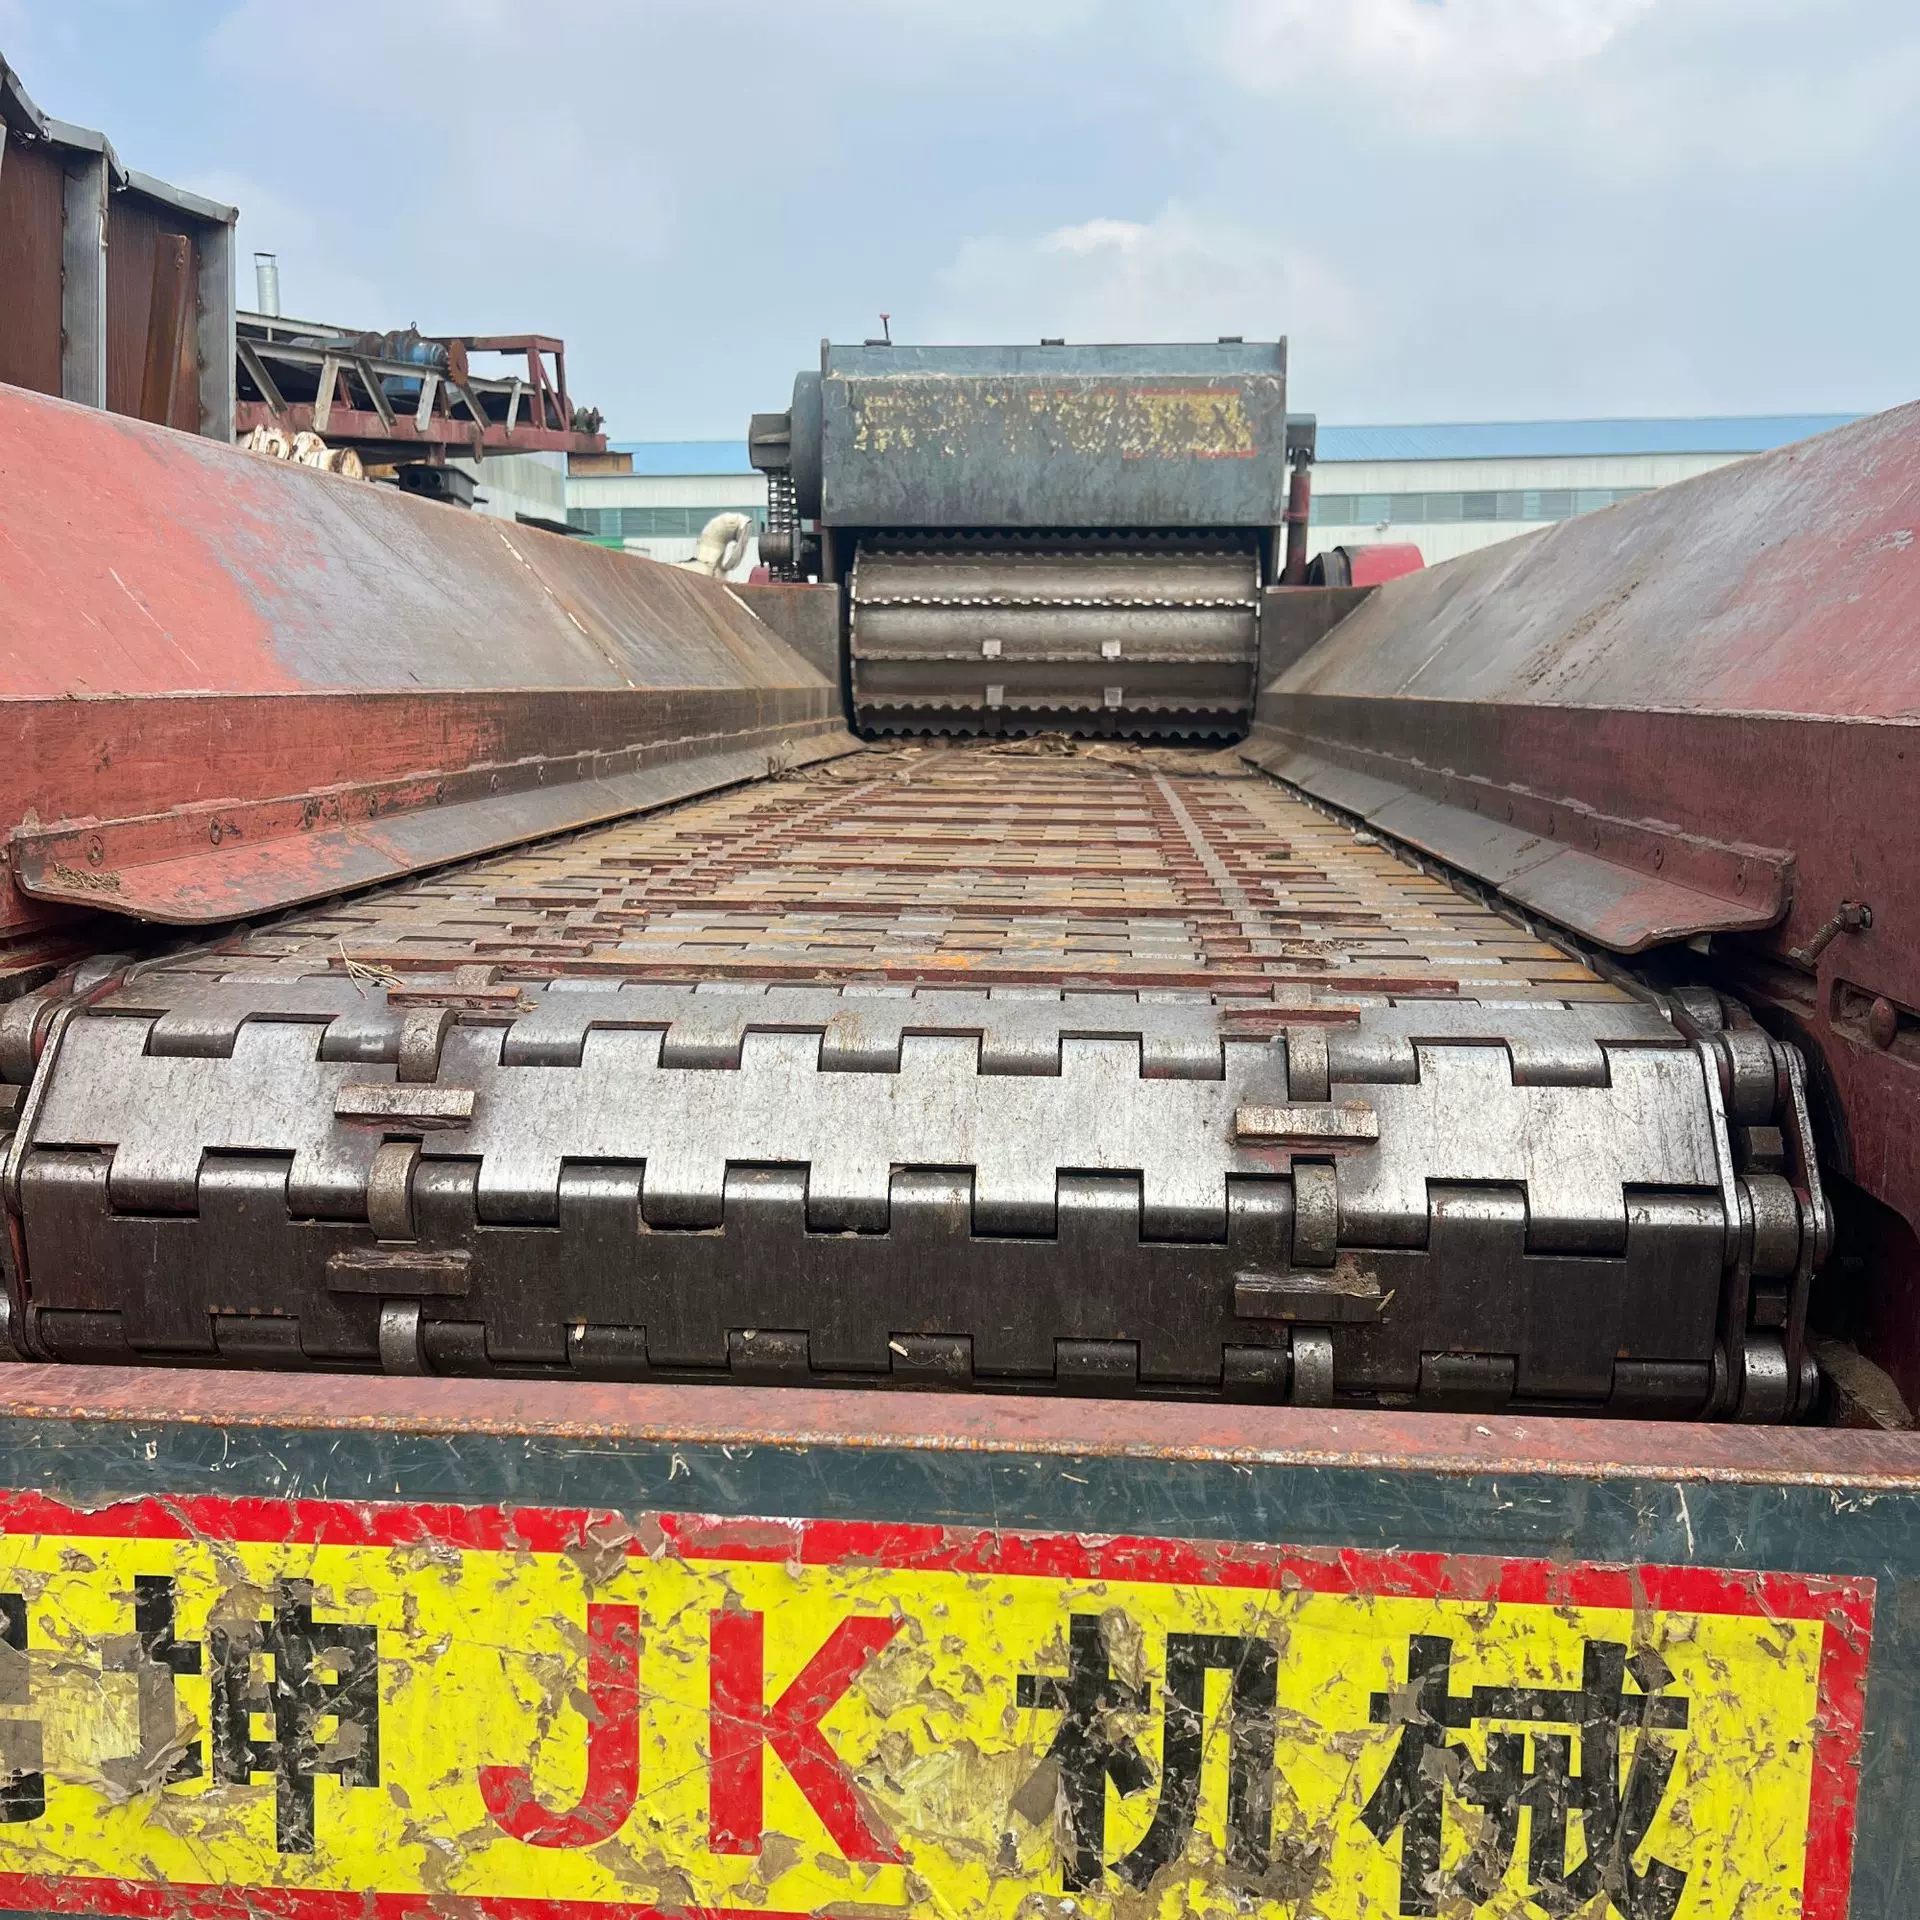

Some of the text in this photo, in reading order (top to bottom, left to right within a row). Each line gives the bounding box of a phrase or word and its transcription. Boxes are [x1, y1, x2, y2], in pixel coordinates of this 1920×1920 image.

[0, 1575, 1690, 1920] 坤 JK 机械
